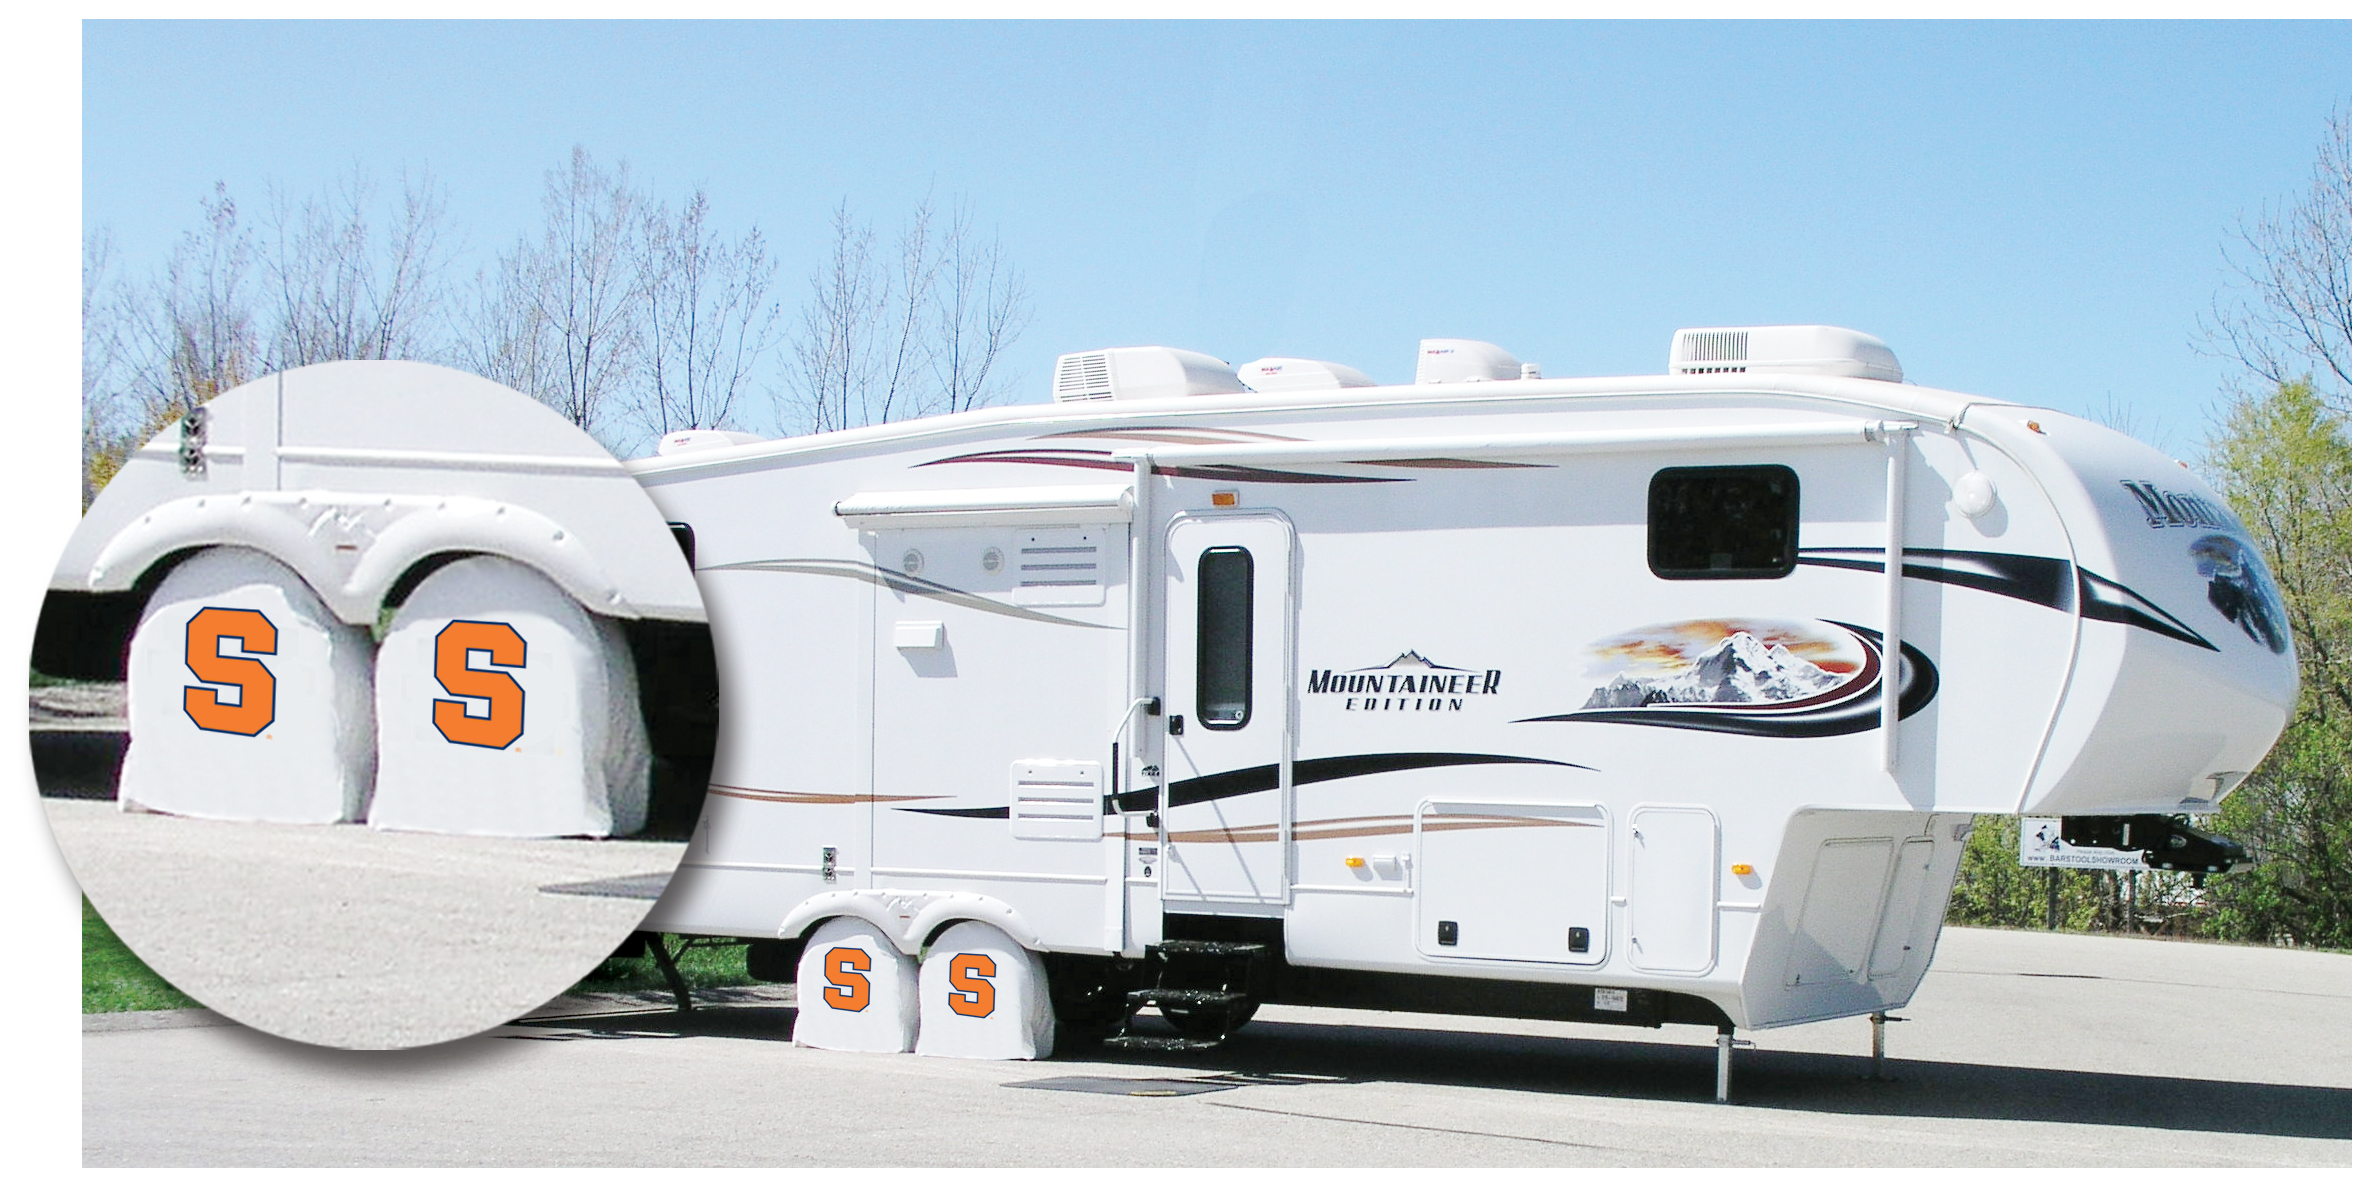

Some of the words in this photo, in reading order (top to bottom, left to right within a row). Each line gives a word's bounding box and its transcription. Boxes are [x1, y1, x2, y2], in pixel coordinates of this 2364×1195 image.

[183, 606, 278, 737] S
[432, 619, 527, 750] S
[1307, 670, 1501, 695] MOUNTAINEER
[1346, 698, 1463, 711] EDITION
[823, 947, 871, 1012] S
[948, 953, 997, 1018] S
